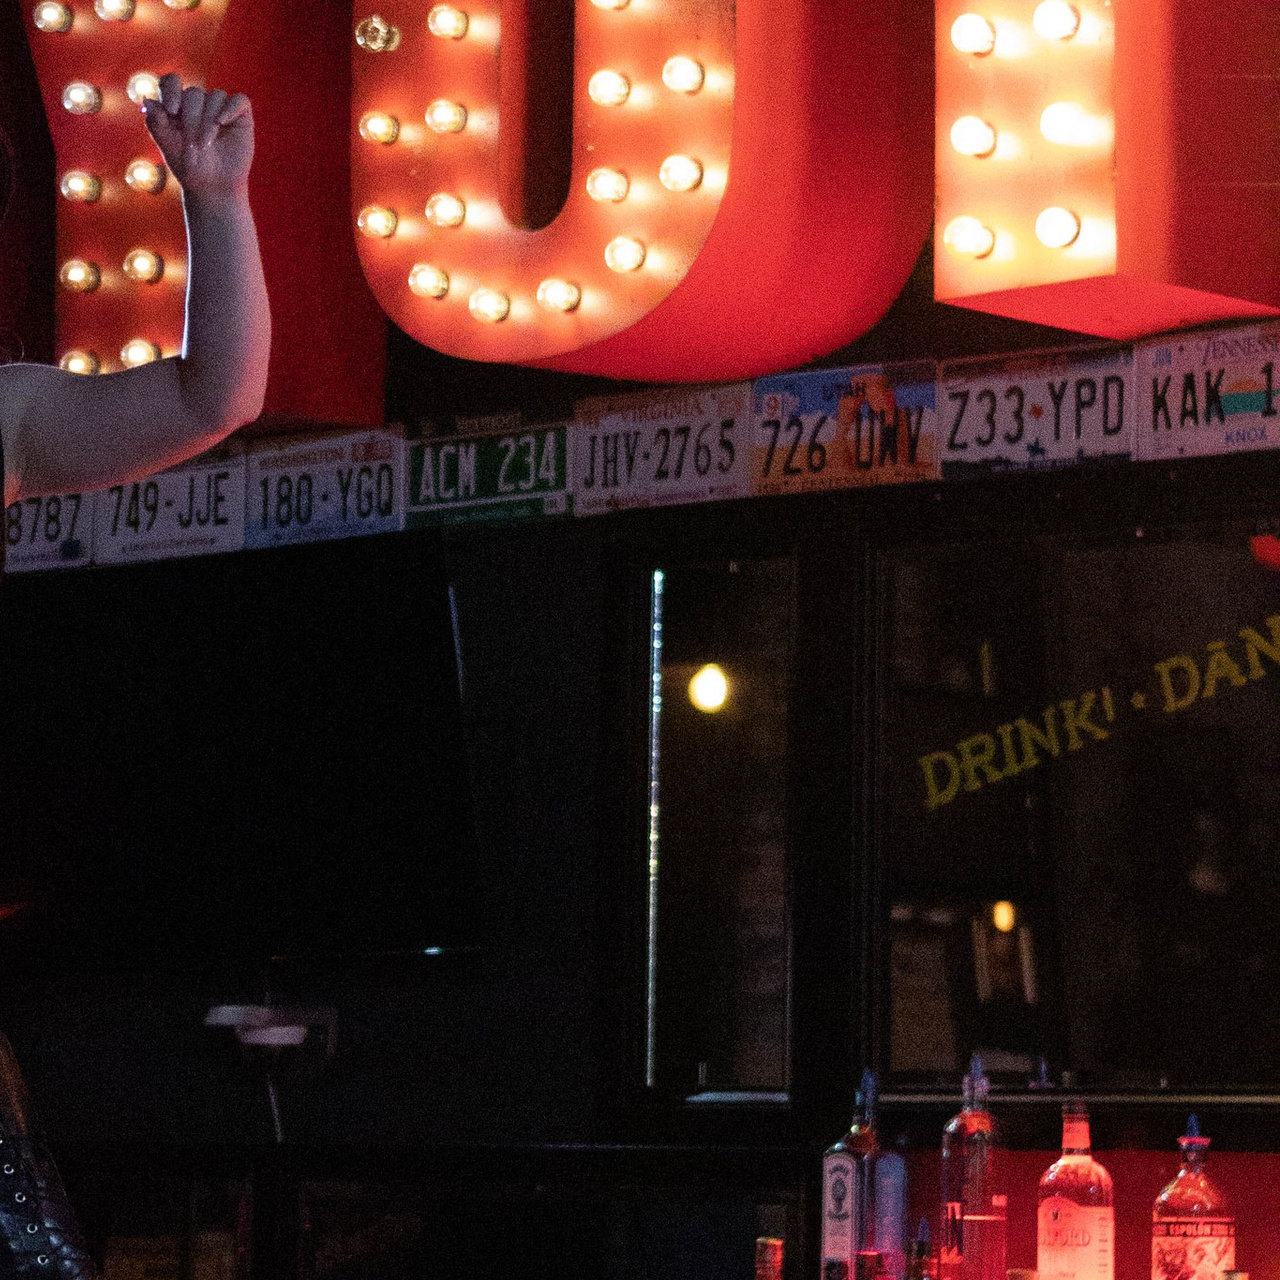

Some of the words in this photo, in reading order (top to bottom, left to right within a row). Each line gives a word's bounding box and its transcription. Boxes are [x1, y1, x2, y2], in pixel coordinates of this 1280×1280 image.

[1048, 375, 1124, 440] YPD
[1151, 368, 1227, 432] KAK
[419, 441, 477, 503] ACM
[498, 430, 557, 493] 234
[762, 414, 828, 478] 726
